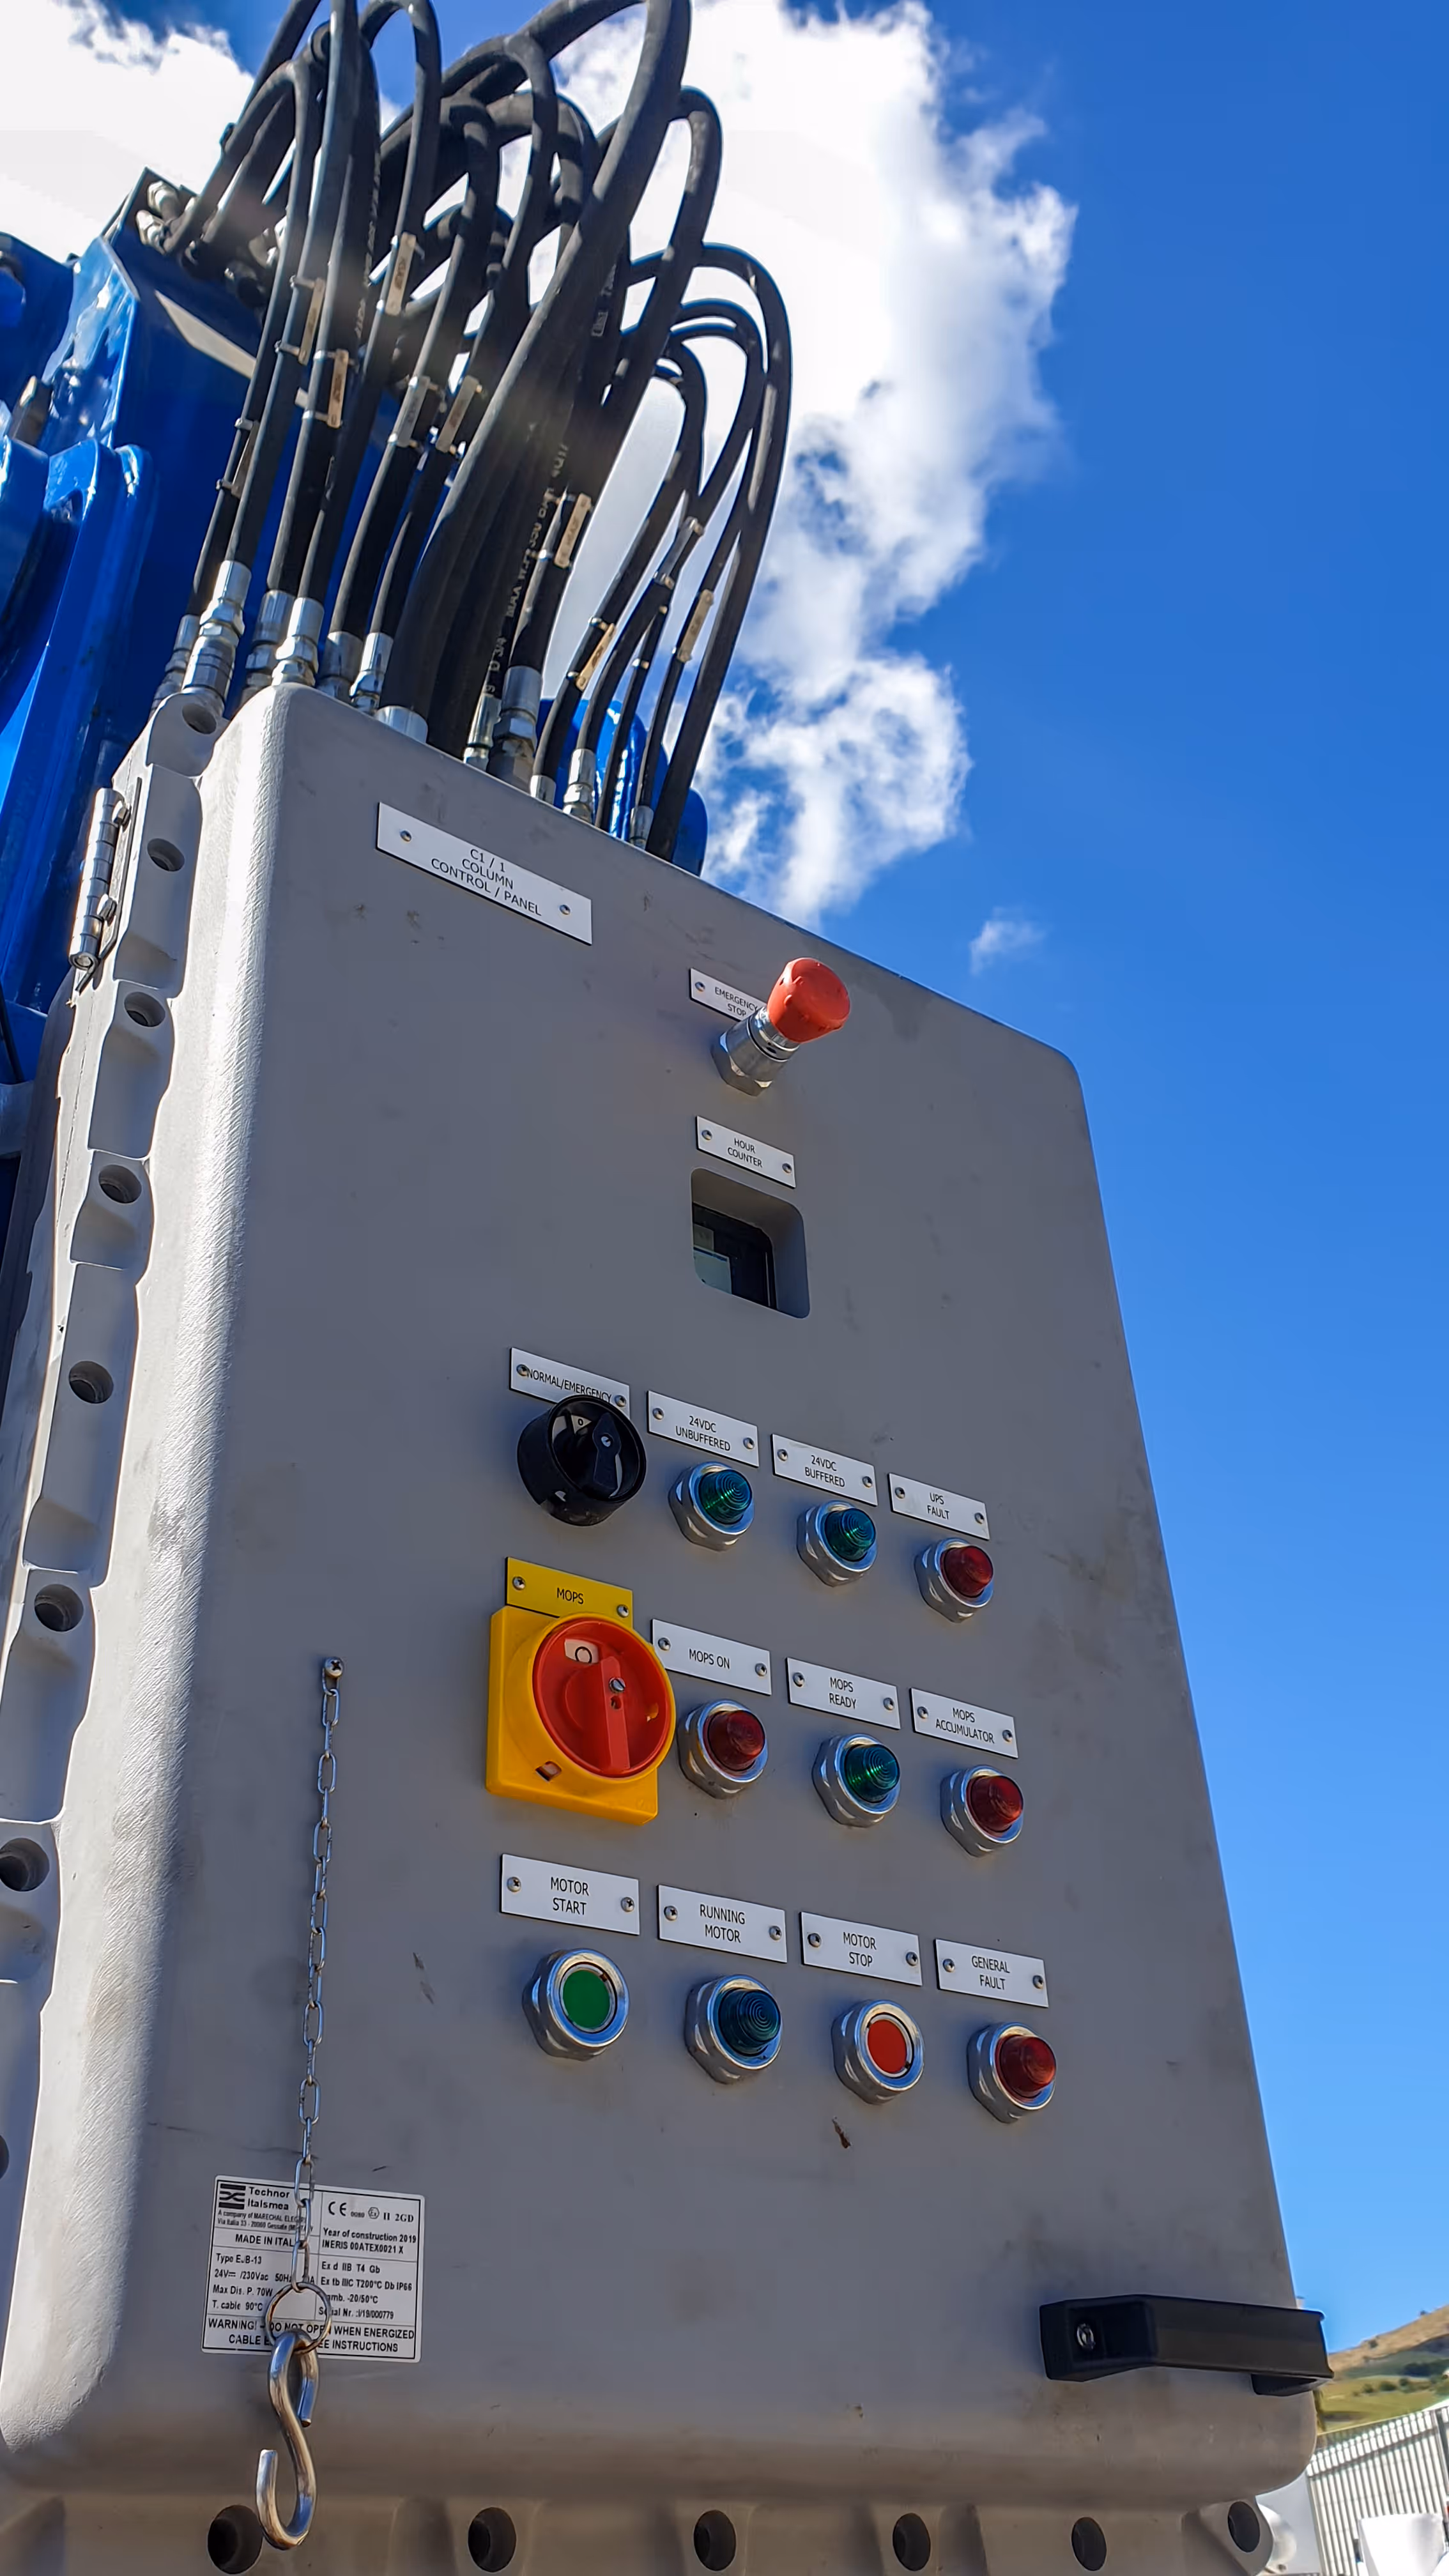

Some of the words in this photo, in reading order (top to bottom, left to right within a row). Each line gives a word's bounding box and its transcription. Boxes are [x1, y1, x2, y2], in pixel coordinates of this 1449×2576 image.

[470, 848, 486, 863] C1
[489, 857, 494, 868] /
[500, 862, 505, 873] 1
[462, 859, 514, 890] COLUMN
[431, 858, 491, 893] CONTROL
[494, 887, 500, 898] /
[504, 891, 542, 916] PANEL
[715, 986, 758, 1011] EMERGENCY
[728, 1003, 746, 1016] STOP
[734, 1137, 756, 1154] HOUR
[727, 1147, 763, 1169] COUNTER
[527, 1368, 611, 1403] NORMAL/EMERGENCY
[689, 1415, 716, 1433] 24VDC
[675, 1425, 731, 1452] UNBUFFERED
[811, 1455, 837, 1471] 24VDC
[804, 1466, 845, 1487] BUFFERED
[930, 1492, 944, 1505] UPS
[927, 1505, 949, 1520] FAULT
[556, 1587, 584, 1605] MOPS
[689, 1648, 714, 1665] MOPS
[716, 1655, 730, 1669] ON
[830, 1677, 854, 1692] MOPS
[829, 1692, 857, 1710] READY
[953, 1707, 975, 1723] MOPS
[935, 1719, 995, 1744] ACCUMULATOR
[551, 1876, 589, 1896] MOTOR
[553, 1897, 586, 1915] START
[700, 1904, 745, 1924] RUNNING
[705, 1924, 741, 1943] MOTOR
[843, 1931, 877, 1950] MOTOR
[848, 1952, 873, 1967] STOP
[971, 1955, 1010, 1974] GENERAL
[979, 1974, 1006, 1990] FAULT
[249, 2186, 290, 2198] Technor
[248, 2198, 289, 2210] Italsmea
[254, 2212, 283, 2222] MARECHAL
[395, 2214, 414, 2223] 2GD
[235, 2234, 261, 2244] MADE
[264, 2237, 273, 2245] IN
[275, 2237, 296, 2247] ITAL
[323, 2227, 341, 2236] Year
[351, 2231, 397, 2242] construction
[399, 2234, 416, 2244] 2019
[322, 2239, 348, 2250] INERIS
[350, 2242, 396, 2254] 00ATEX0021
[399, 2246, 404, 2254] X
[216, 2253, 234, 2264] Type
[321, 2261, 330, 2270] Ex
[333, 2262, 338, 2271] d
[356, 2264, 365, 2273] T4
[369, 2265, 380, 2274] Gb
[213, 2284, 228, 2294] Max
[230, 2286, 244, 2295] Dis.
[257, 2288, 273, 2297] 70W
[321, 2276, 330, 2285] Ex
[385, 2281, 395, 2290] Db
[396, 2281, 412, 2291] IP66
[221, 2301, 241, 2310] cable
[245, 2302, 263, 2311] 90°C
[342, 2308, 353, 2317] Nr.
[208, 2318, 256, 2330] WARNING!
[270, 2322, 282, 2331] DO
[334, 2326, 362, 2336] WHEN
[364, 2327, 415, 2339] ENERGIZED
[229, 2334, 261, 2345] CABLE
[332, 2340, 398, 2352] INSTRUCTIONS
